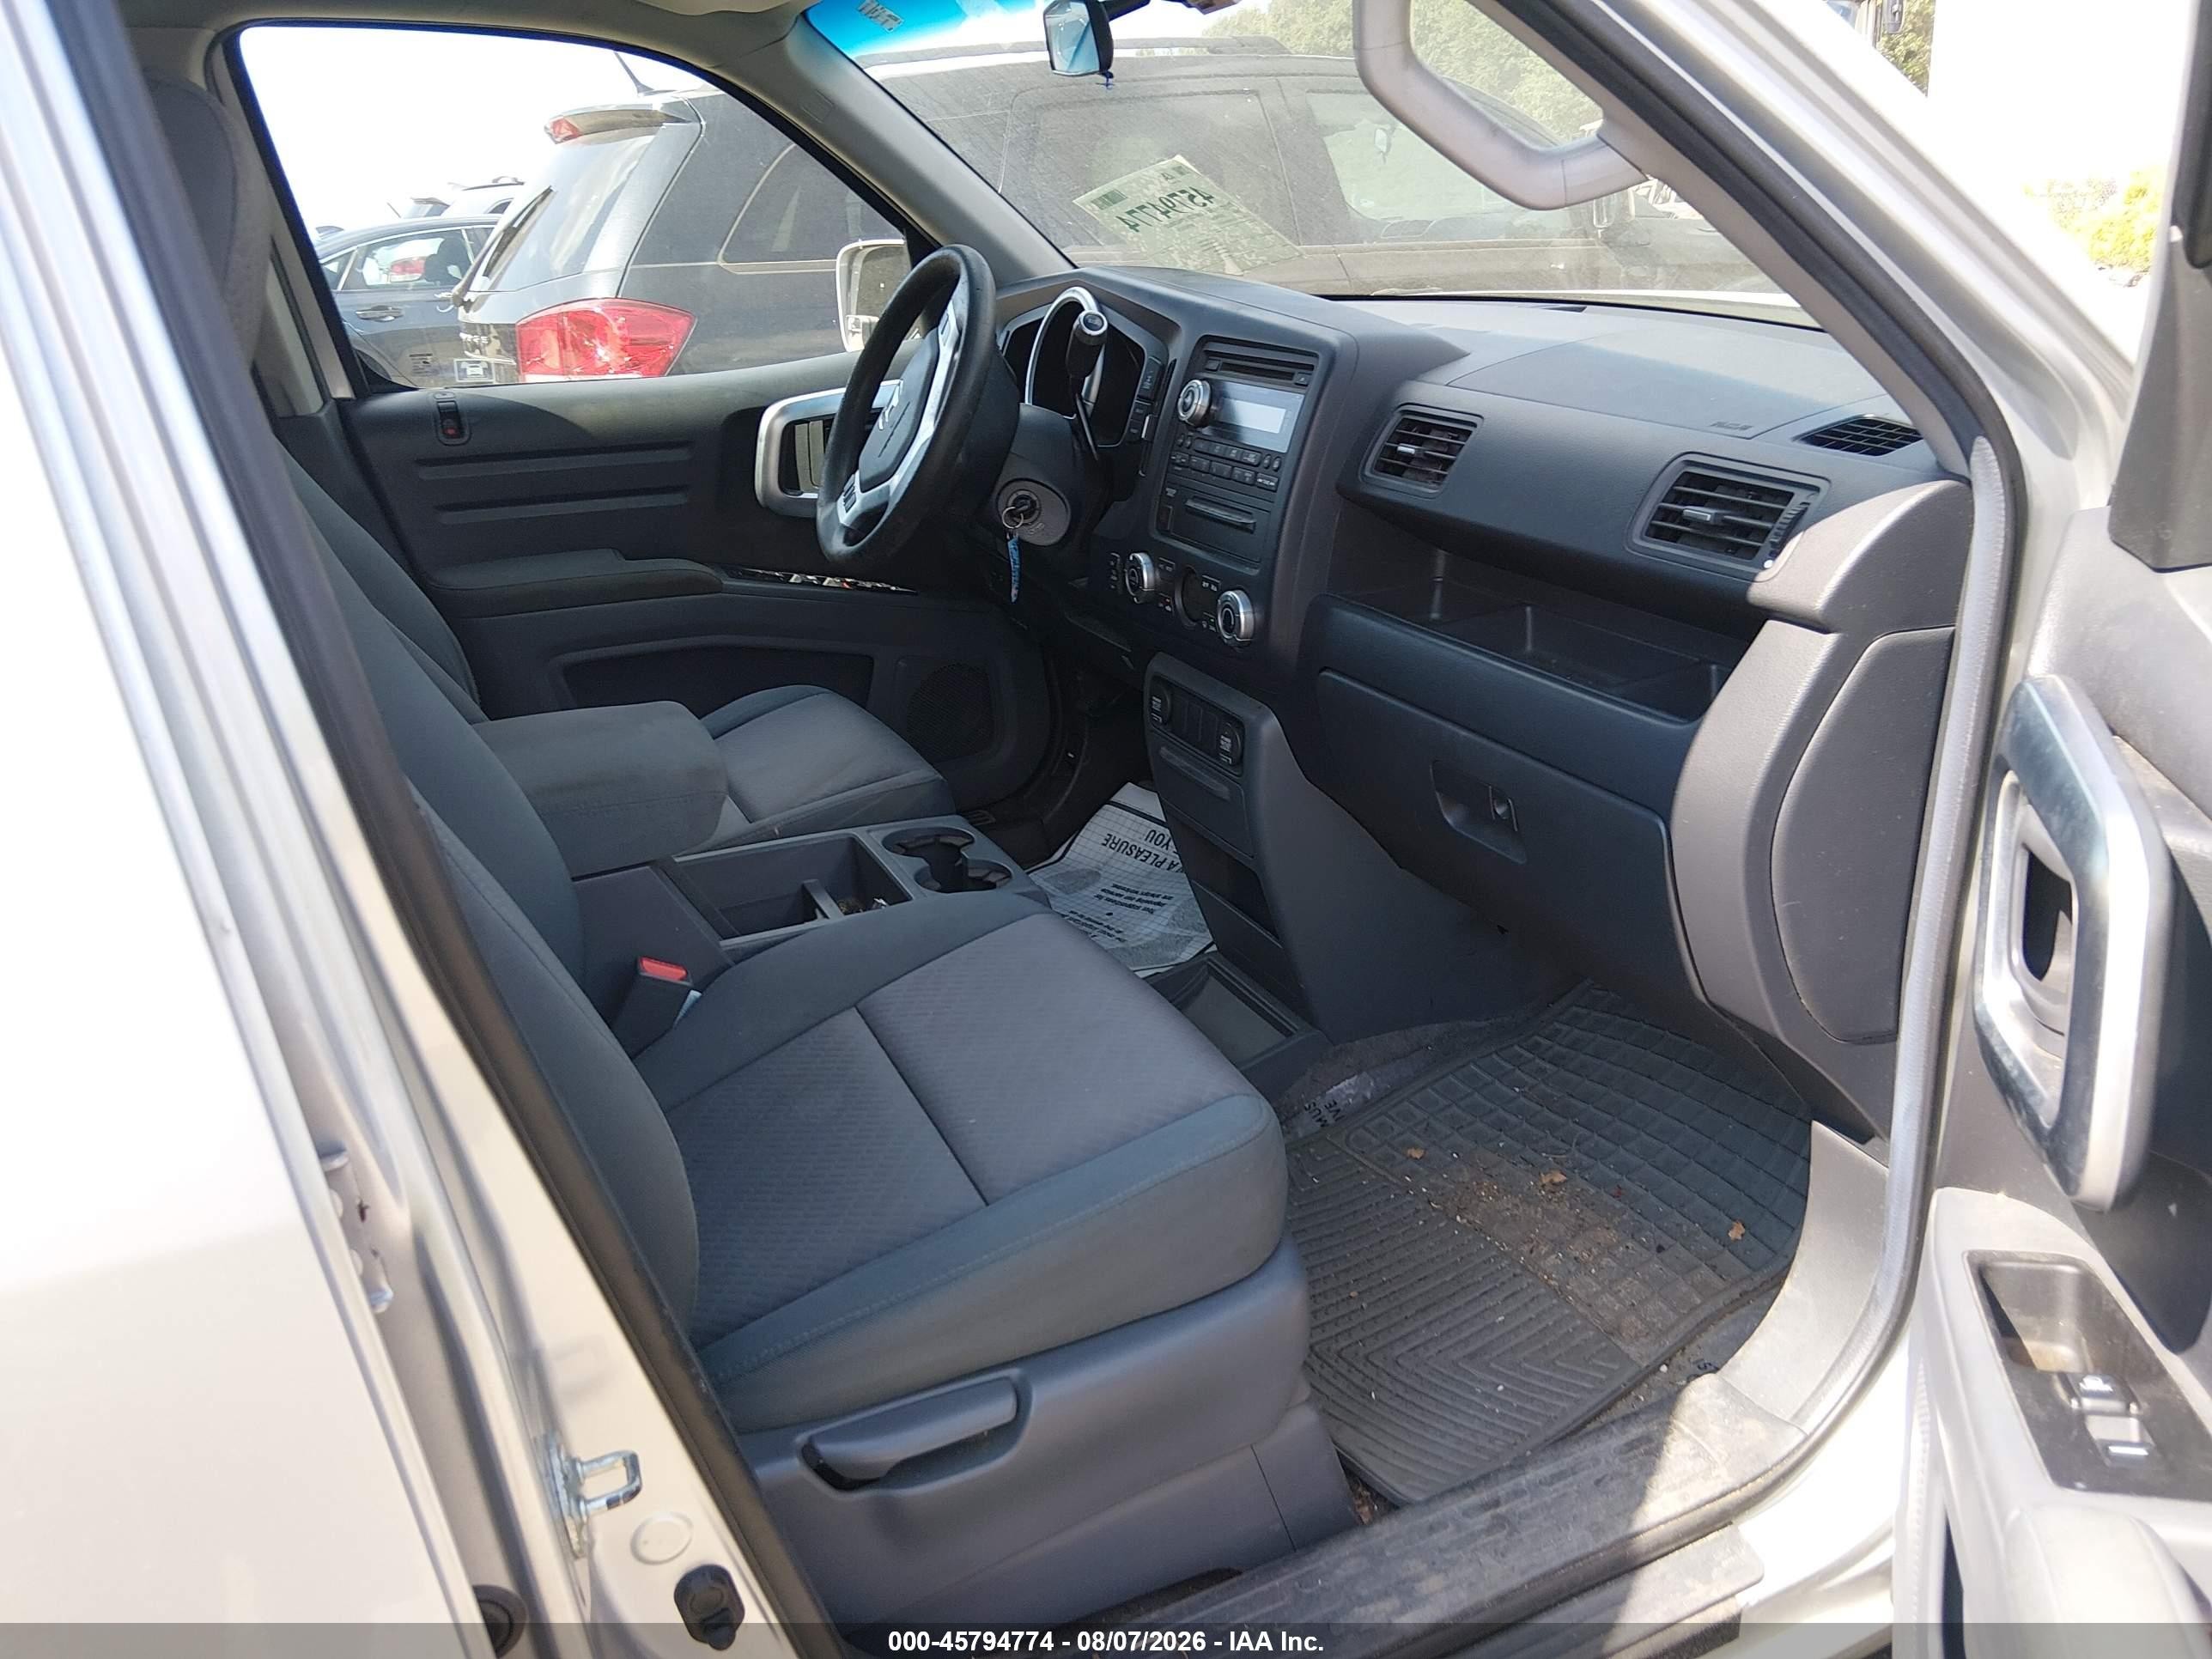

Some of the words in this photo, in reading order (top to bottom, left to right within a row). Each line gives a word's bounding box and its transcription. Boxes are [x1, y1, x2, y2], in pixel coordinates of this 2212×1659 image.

[1145, 829, 1171, 849] YOU
[1102, 833, 1167, 868] PLEASURE
[1167, 860, 1179, 872] A
